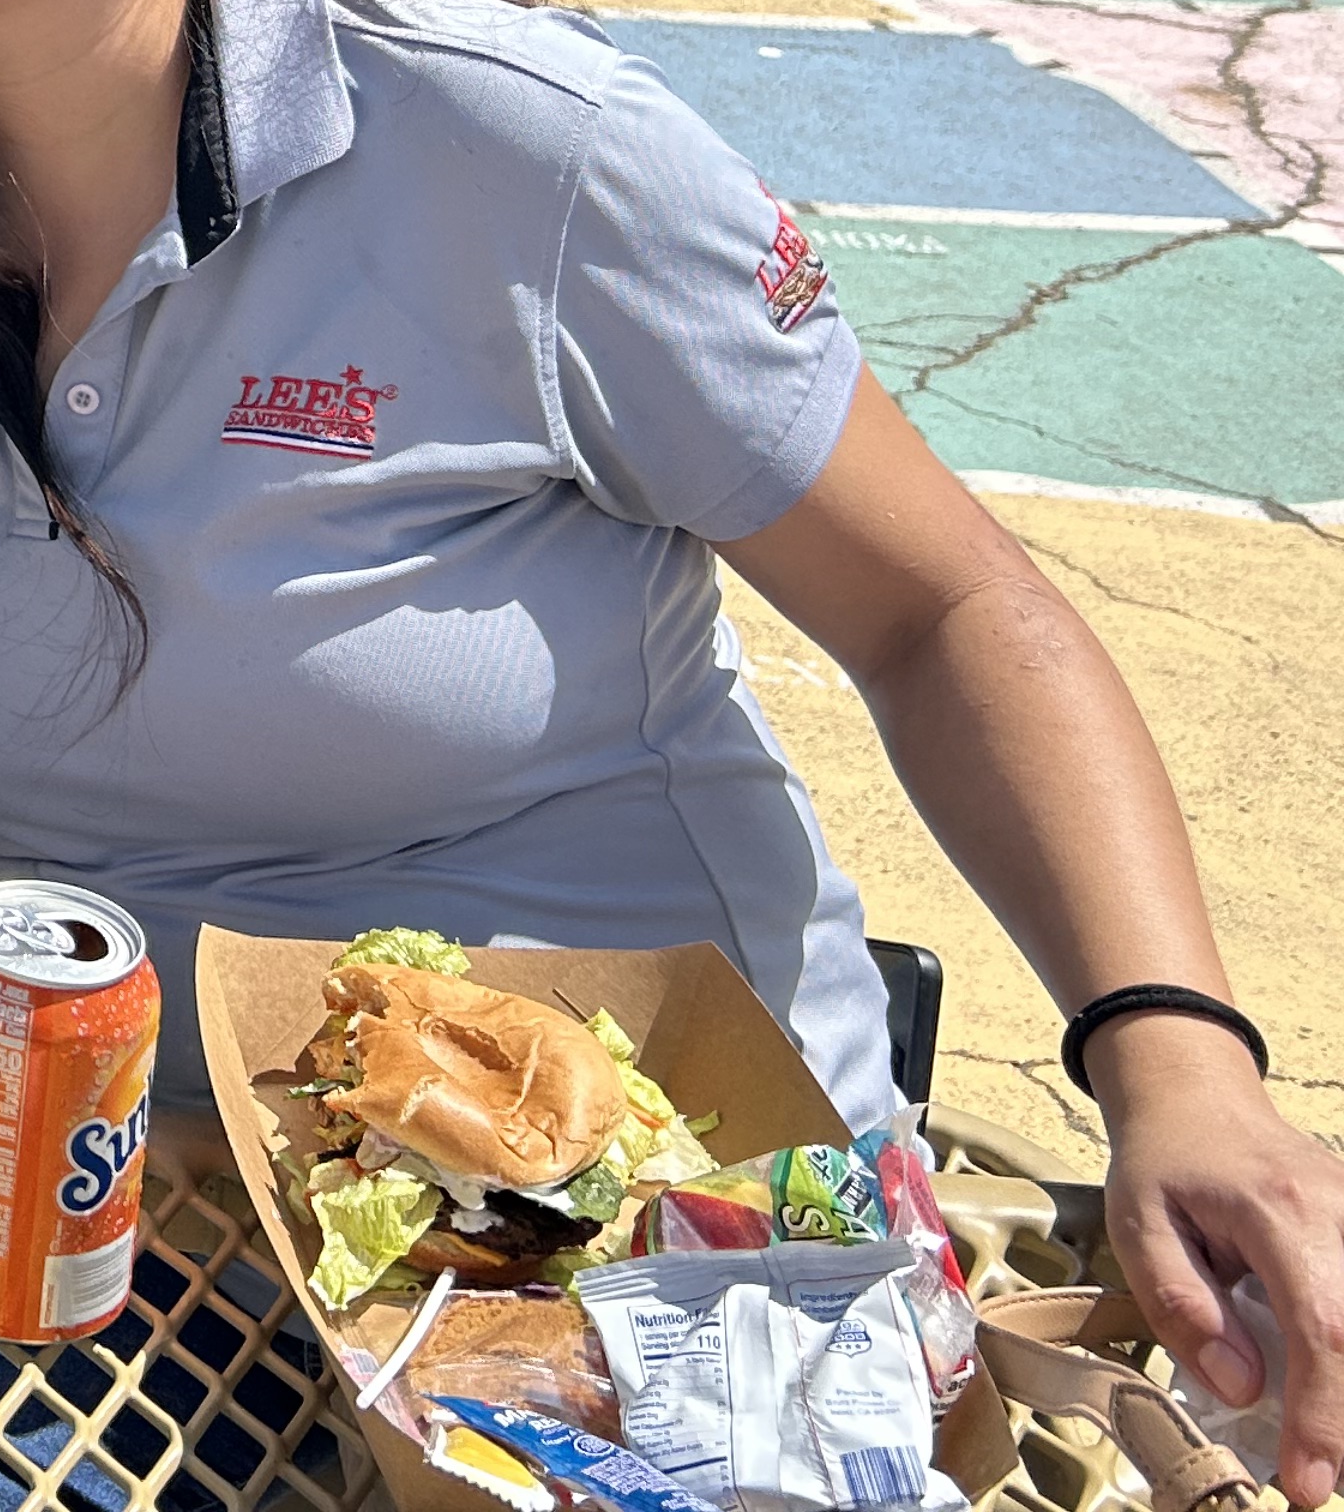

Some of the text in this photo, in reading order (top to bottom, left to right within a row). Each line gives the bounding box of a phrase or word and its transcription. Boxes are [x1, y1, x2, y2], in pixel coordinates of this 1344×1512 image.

[231, 365, 379, 425] LEE'S
[223, 409, 376, 445] SANDWICHES
[634, 1311, 693, 1329] Nutrition
[697, 1334, 722, 1350] 110
